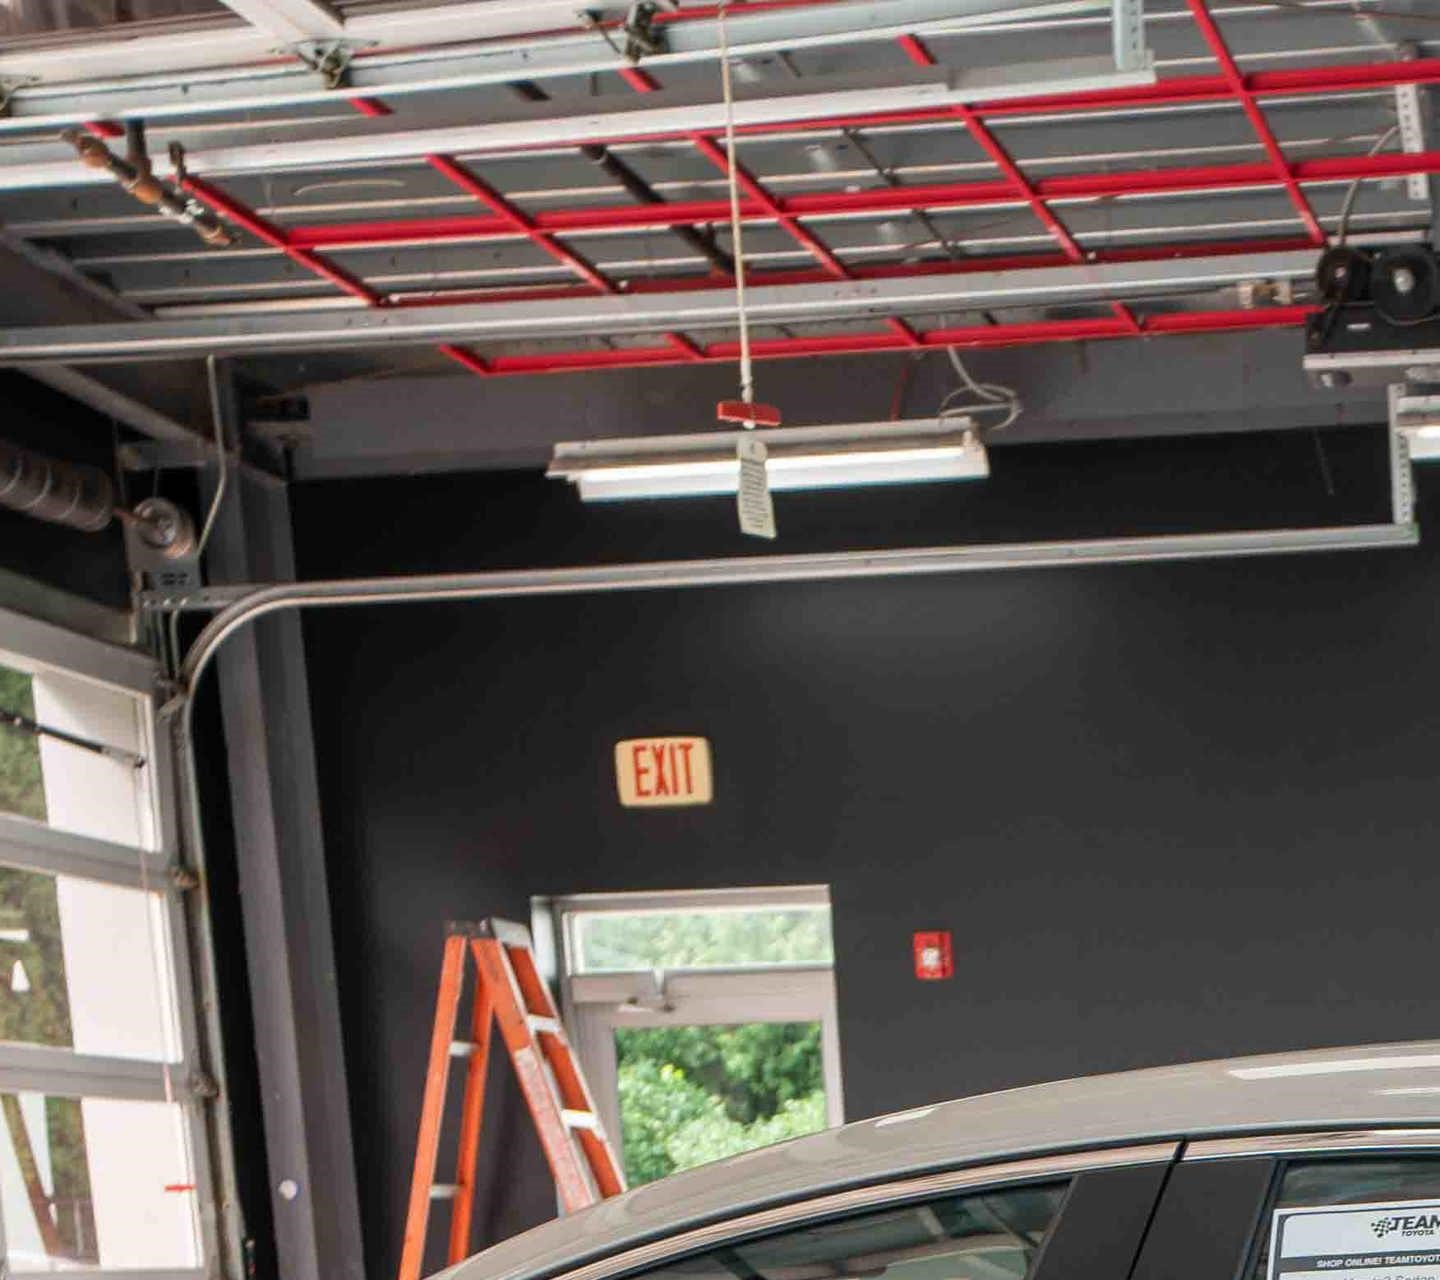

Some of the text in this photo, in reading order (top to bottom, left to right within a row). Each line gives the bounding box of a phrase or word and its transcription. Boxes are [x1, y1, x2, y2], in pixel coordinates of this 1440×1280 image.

[633, 743, 694, 798] EXIT
[1401, 1230, 1436, 1238] TOYOTA
[1316, 1258, 1344, 1268] SHOP
[1346, 1256, 1382, 1268] ONLINE!
